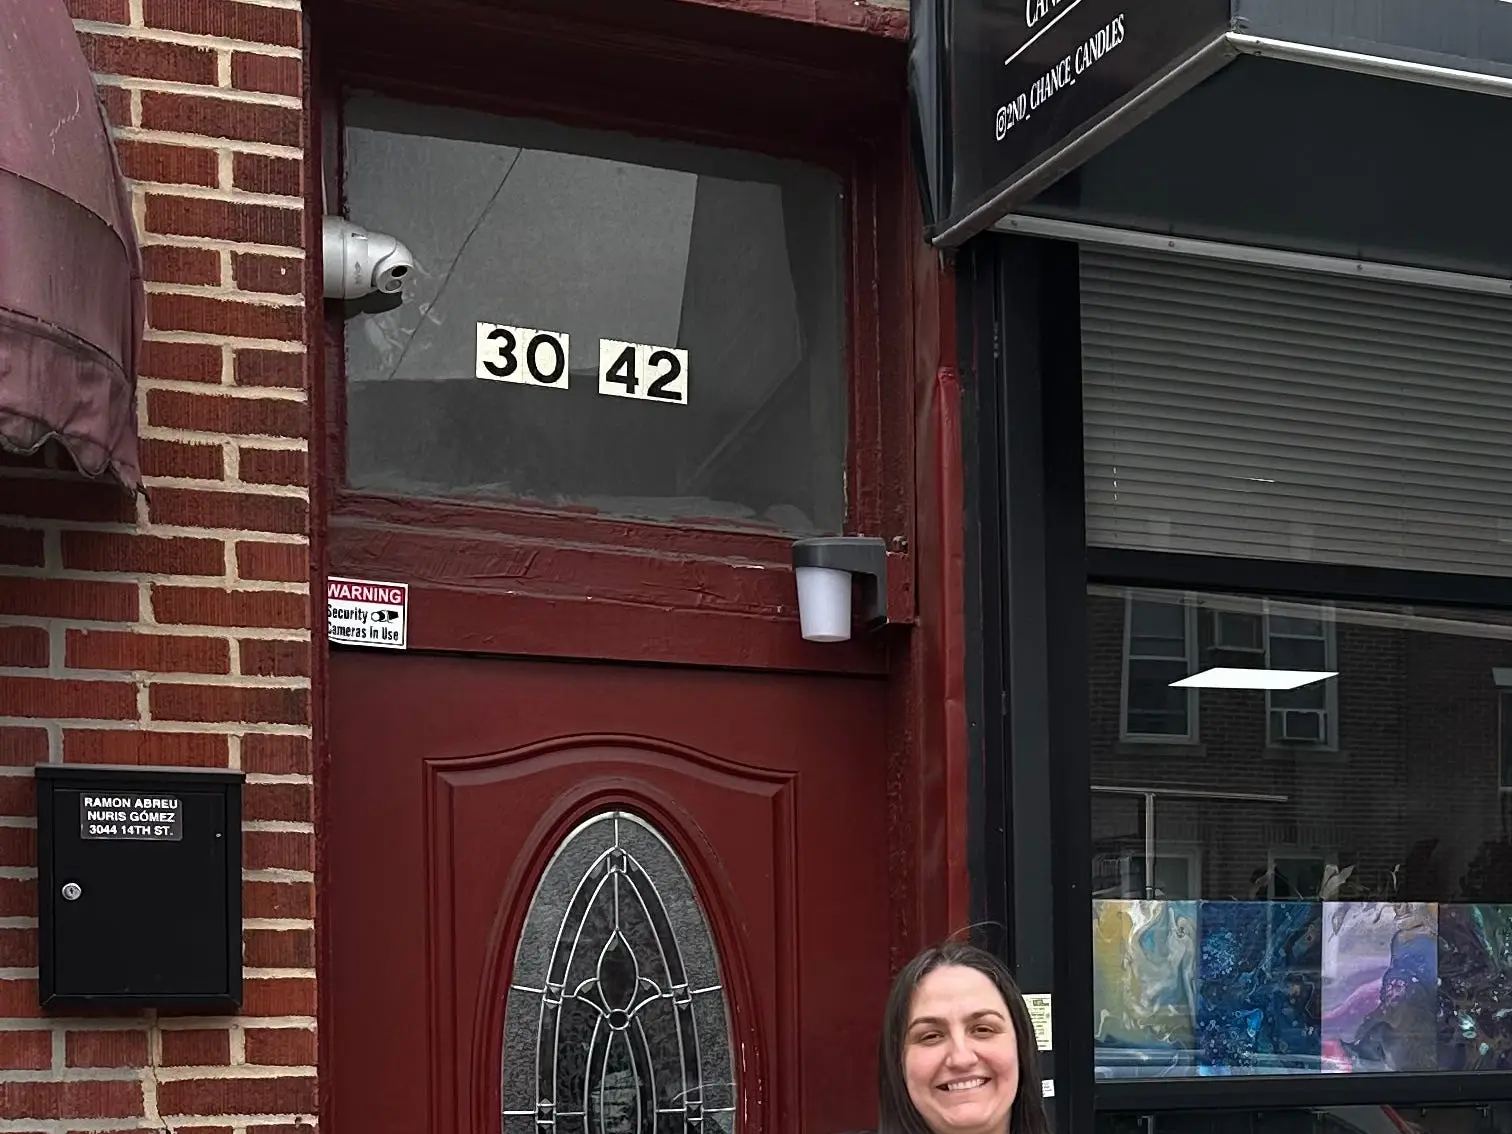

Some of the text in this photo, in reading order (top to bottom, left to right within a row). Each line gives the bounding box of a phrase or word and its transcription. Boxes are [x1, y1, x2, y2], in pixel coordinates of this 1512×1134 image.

[1007, 13, 1125, 130] 2ND_CHANCE_CANDLES
[483, 328, 682, 400] 30 42
[328, 583, 402, 604] WARNING
[328, 604, 368, 624] Security
[328, 621, 367, 639] Cameras
[382, 626, 399, 641] Use
[84, 797, 178, 809] RAMON ABREU
[87, 809, 176, 823] NURIS GÓMEZ
[88, 824, 174, 836] 3044 14TH ST.
